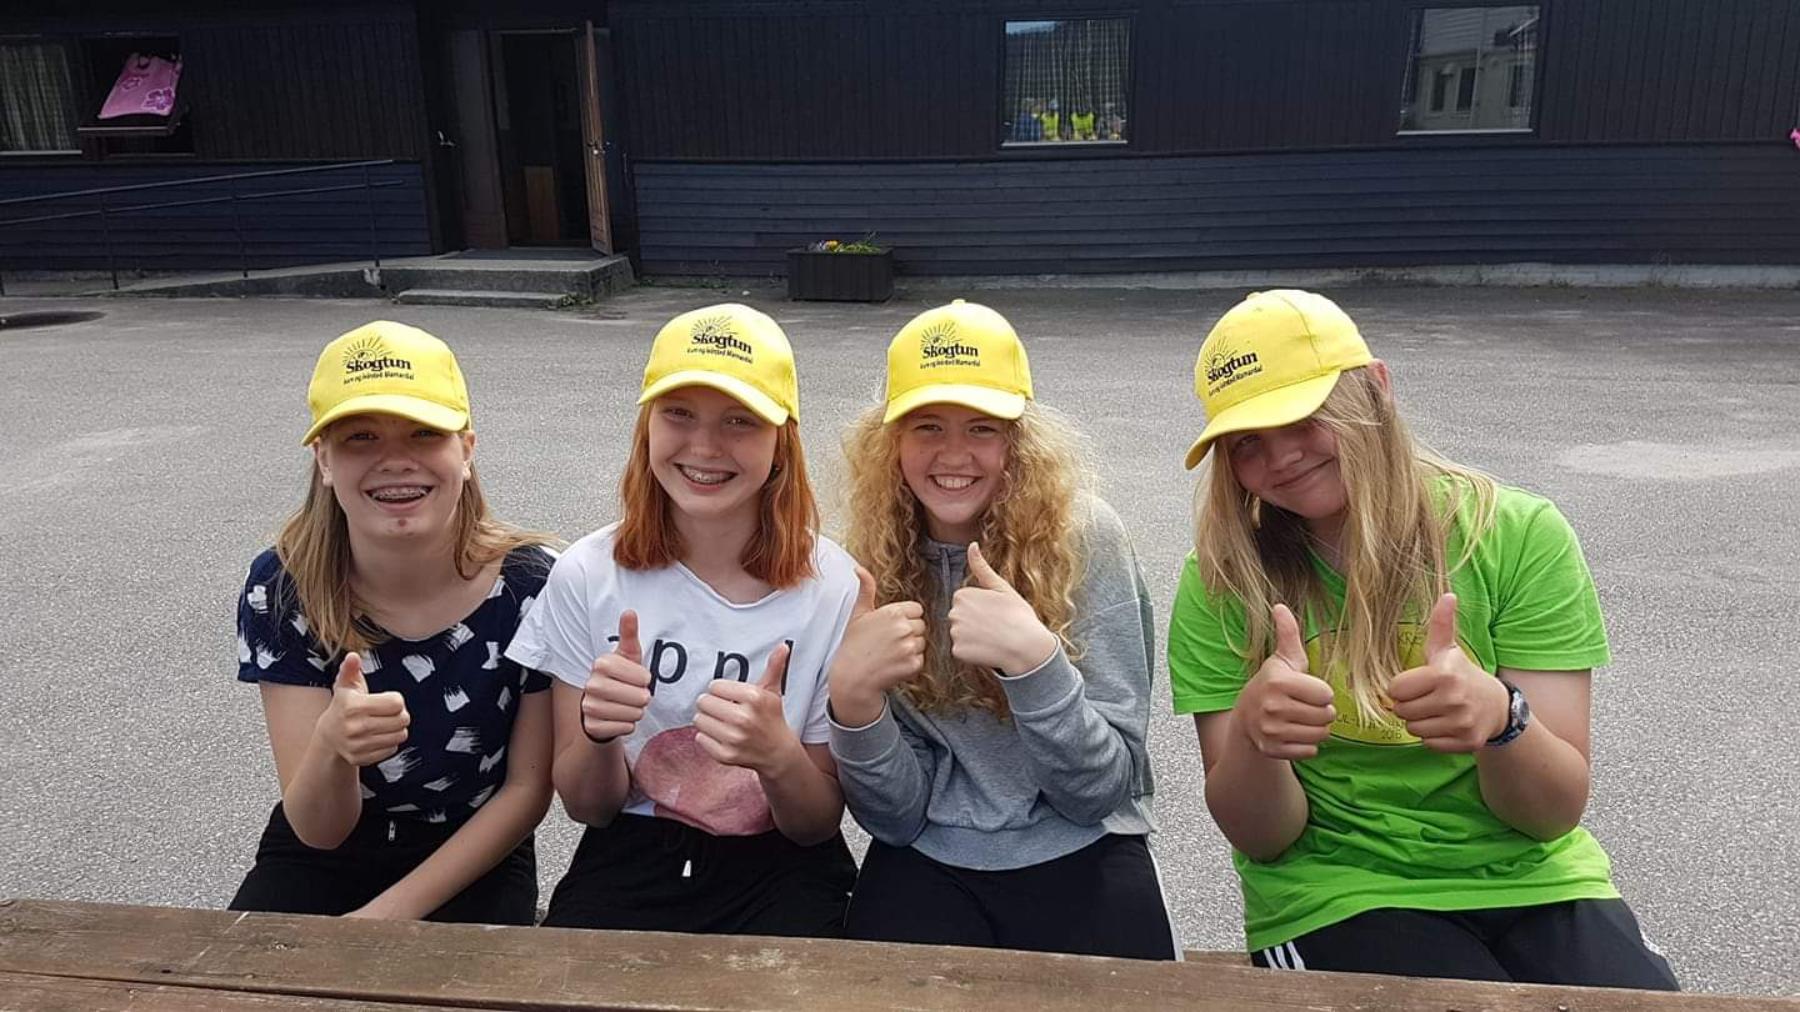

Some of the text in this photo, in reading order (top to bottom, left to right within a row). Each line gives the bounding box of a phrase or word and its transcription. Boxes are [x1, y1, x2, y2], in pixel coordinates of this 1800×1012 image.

[691, 333, 752, 354] Skogtun
[922, 343, 978, 359] Skogtun
[346, 356, 411, 374] Skogtun
[1208, 352, 1258, 386] Skogtun
